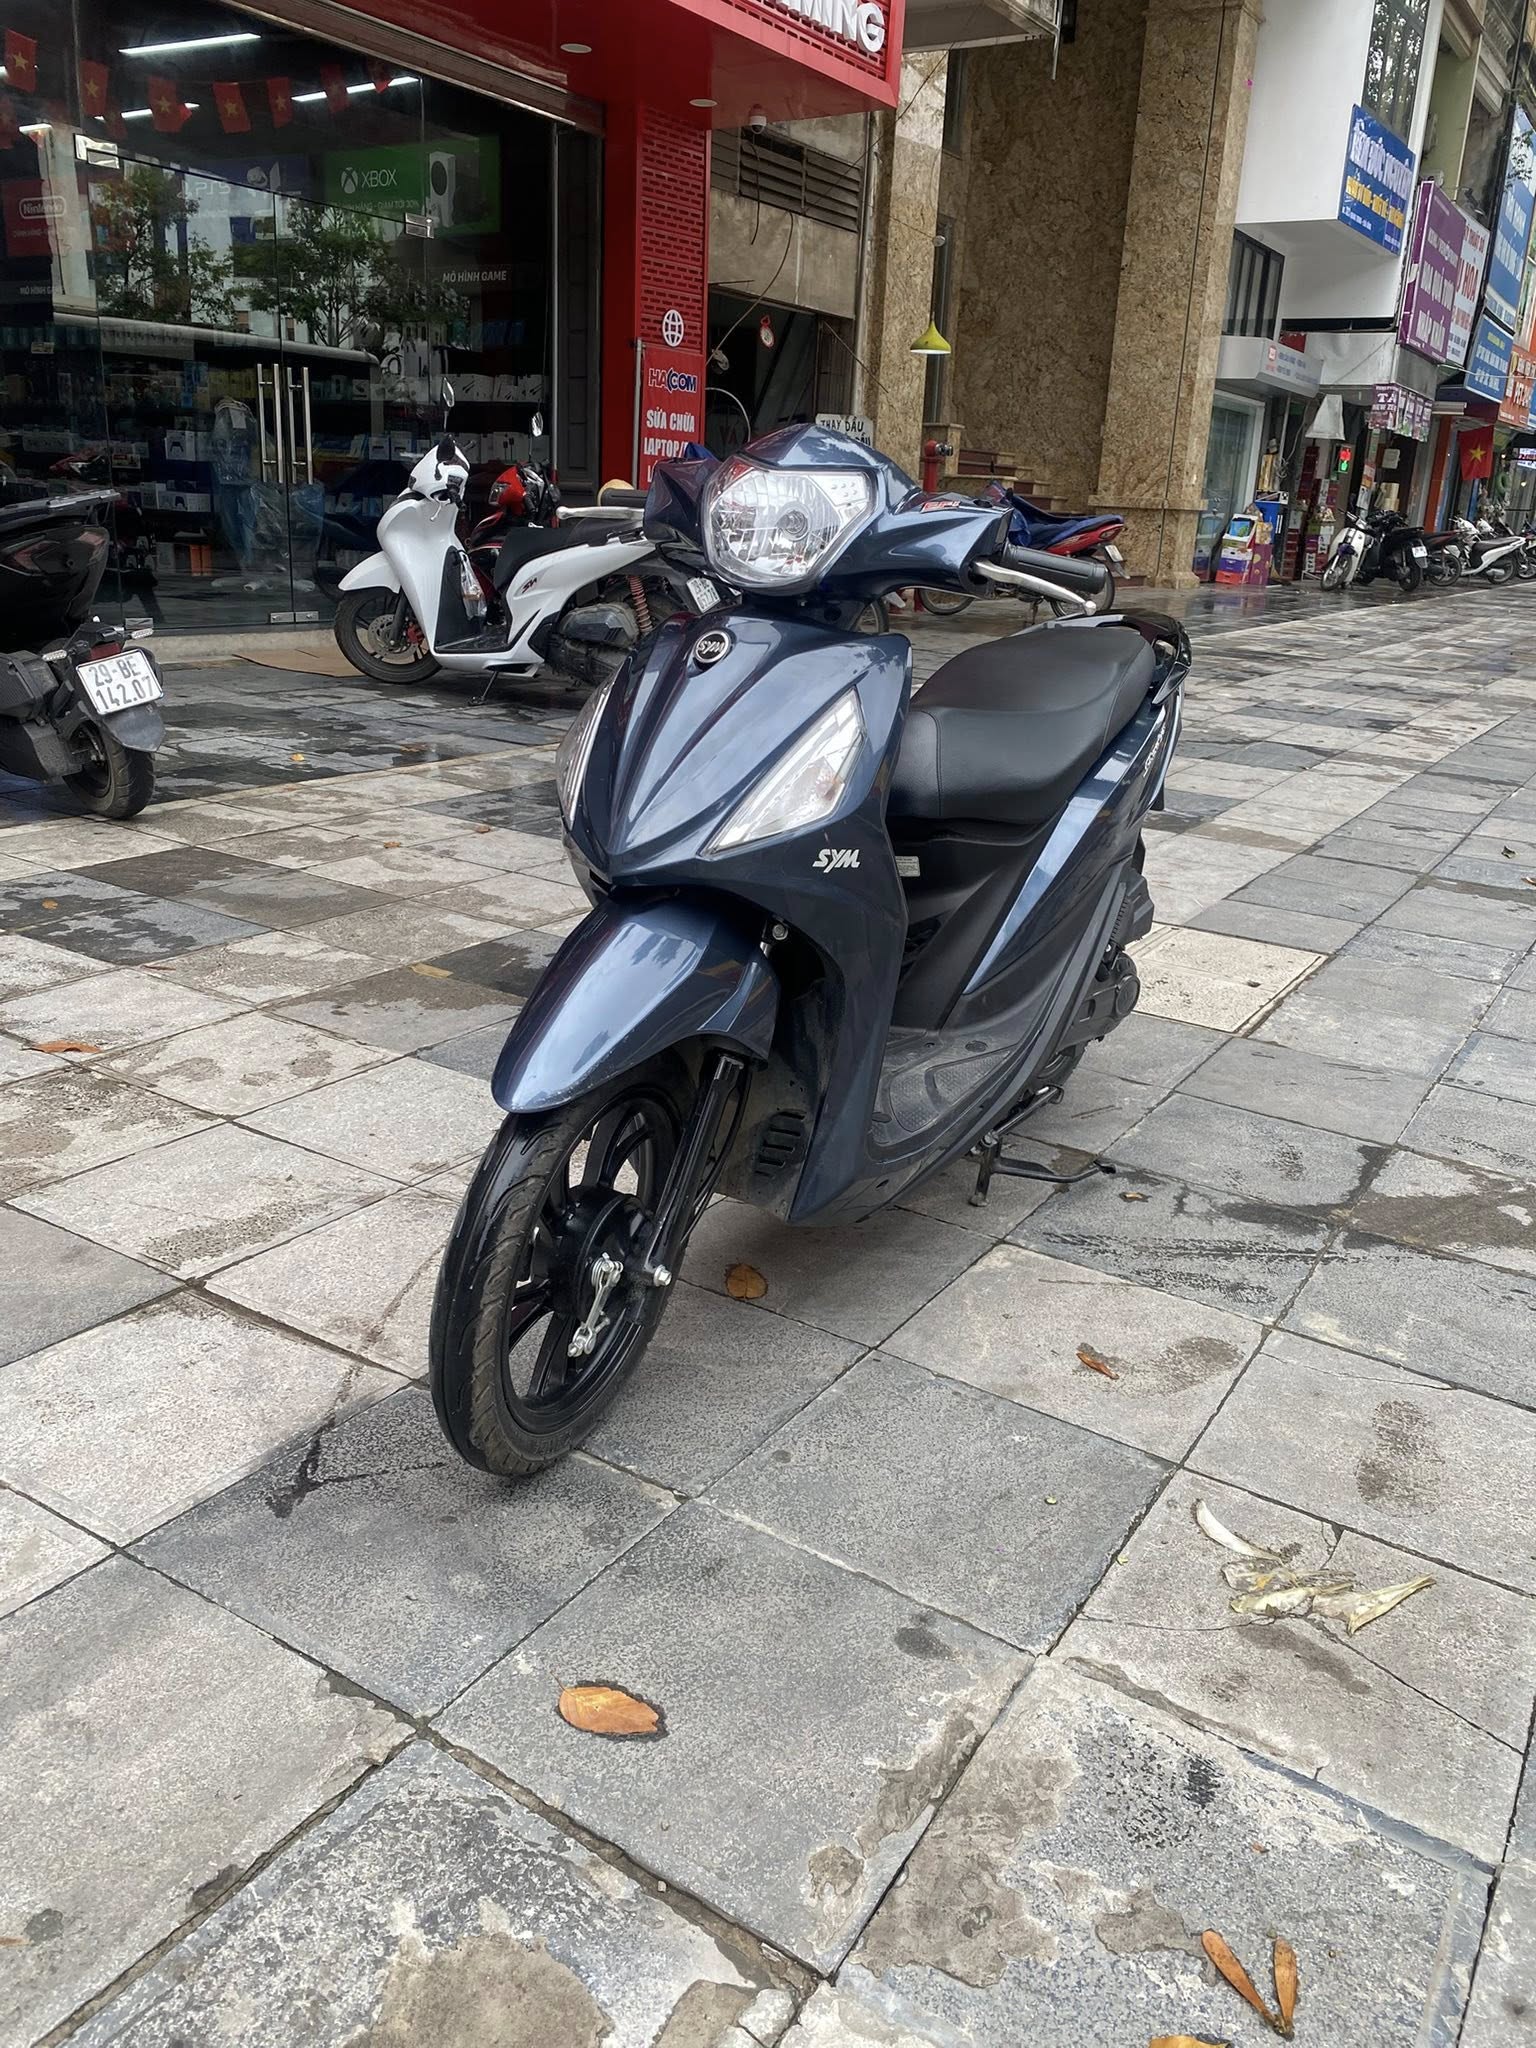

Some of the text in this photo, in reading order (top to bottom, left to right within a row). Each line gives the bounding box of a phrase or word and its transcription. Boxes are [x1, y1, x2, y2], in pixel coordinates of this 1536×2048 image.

[361, 169, 397, 188] XBOX
[481, 270, 507, 281] GAME
[648, 368, 698, 393] HACOM
[646, 407, 695, 433] SỬA CHỮA
[699, 640, 725, 654] SYM
[89, 656, 140, 687] 29-BE
[96, 675, 154, 710] 142.07
[812, 849, 860, 873] SYM
